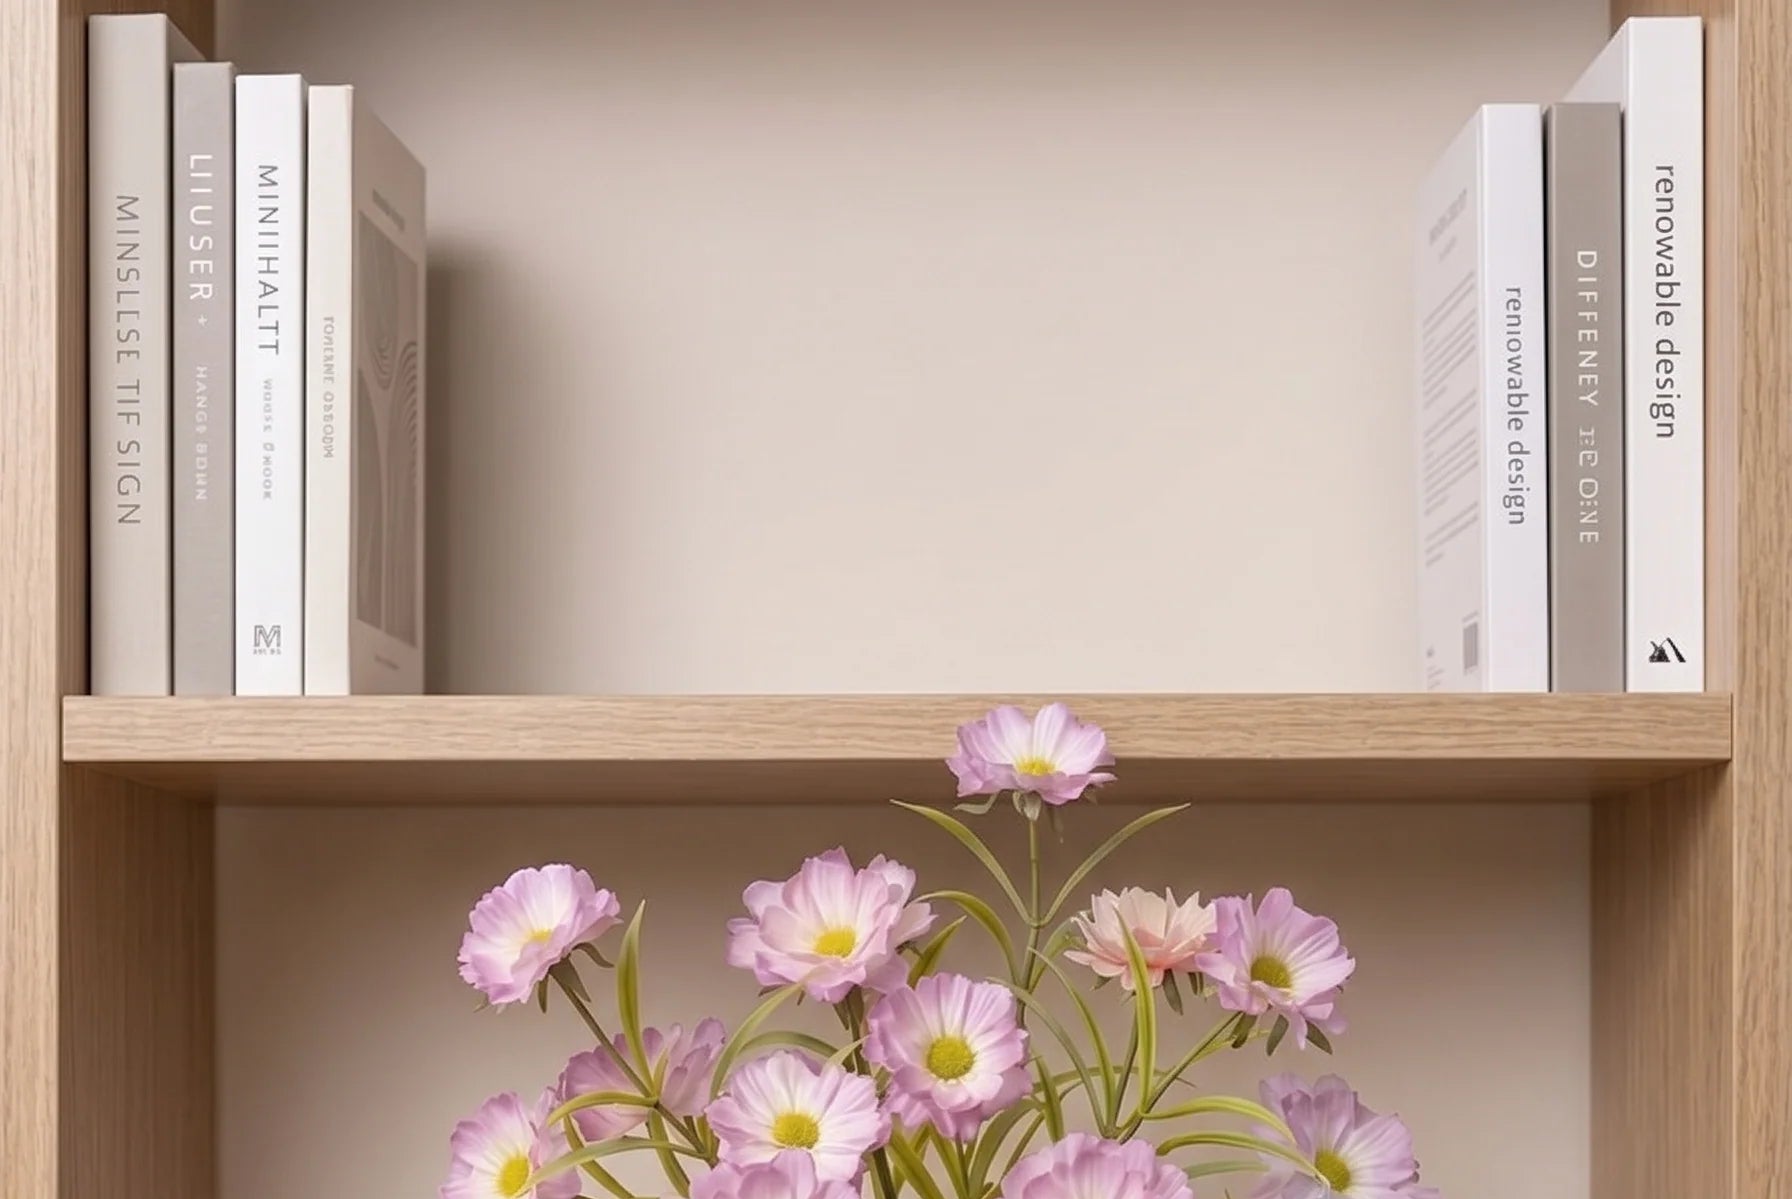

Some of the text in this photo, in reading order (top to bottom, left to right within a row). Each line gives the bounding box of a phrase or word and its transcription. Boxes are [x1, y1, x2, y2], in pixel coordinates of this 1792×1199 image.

[257, 164, 280, 356] MINIIHALTT
[1649, 165, 1682, 438] renowable design
[1576, 250, 1599, 406] DIFFENEY
[116, 378, 141, 427] TIF
[116, 439, 141, 524] SIGN
[1502, 440, 1531, 525] design
